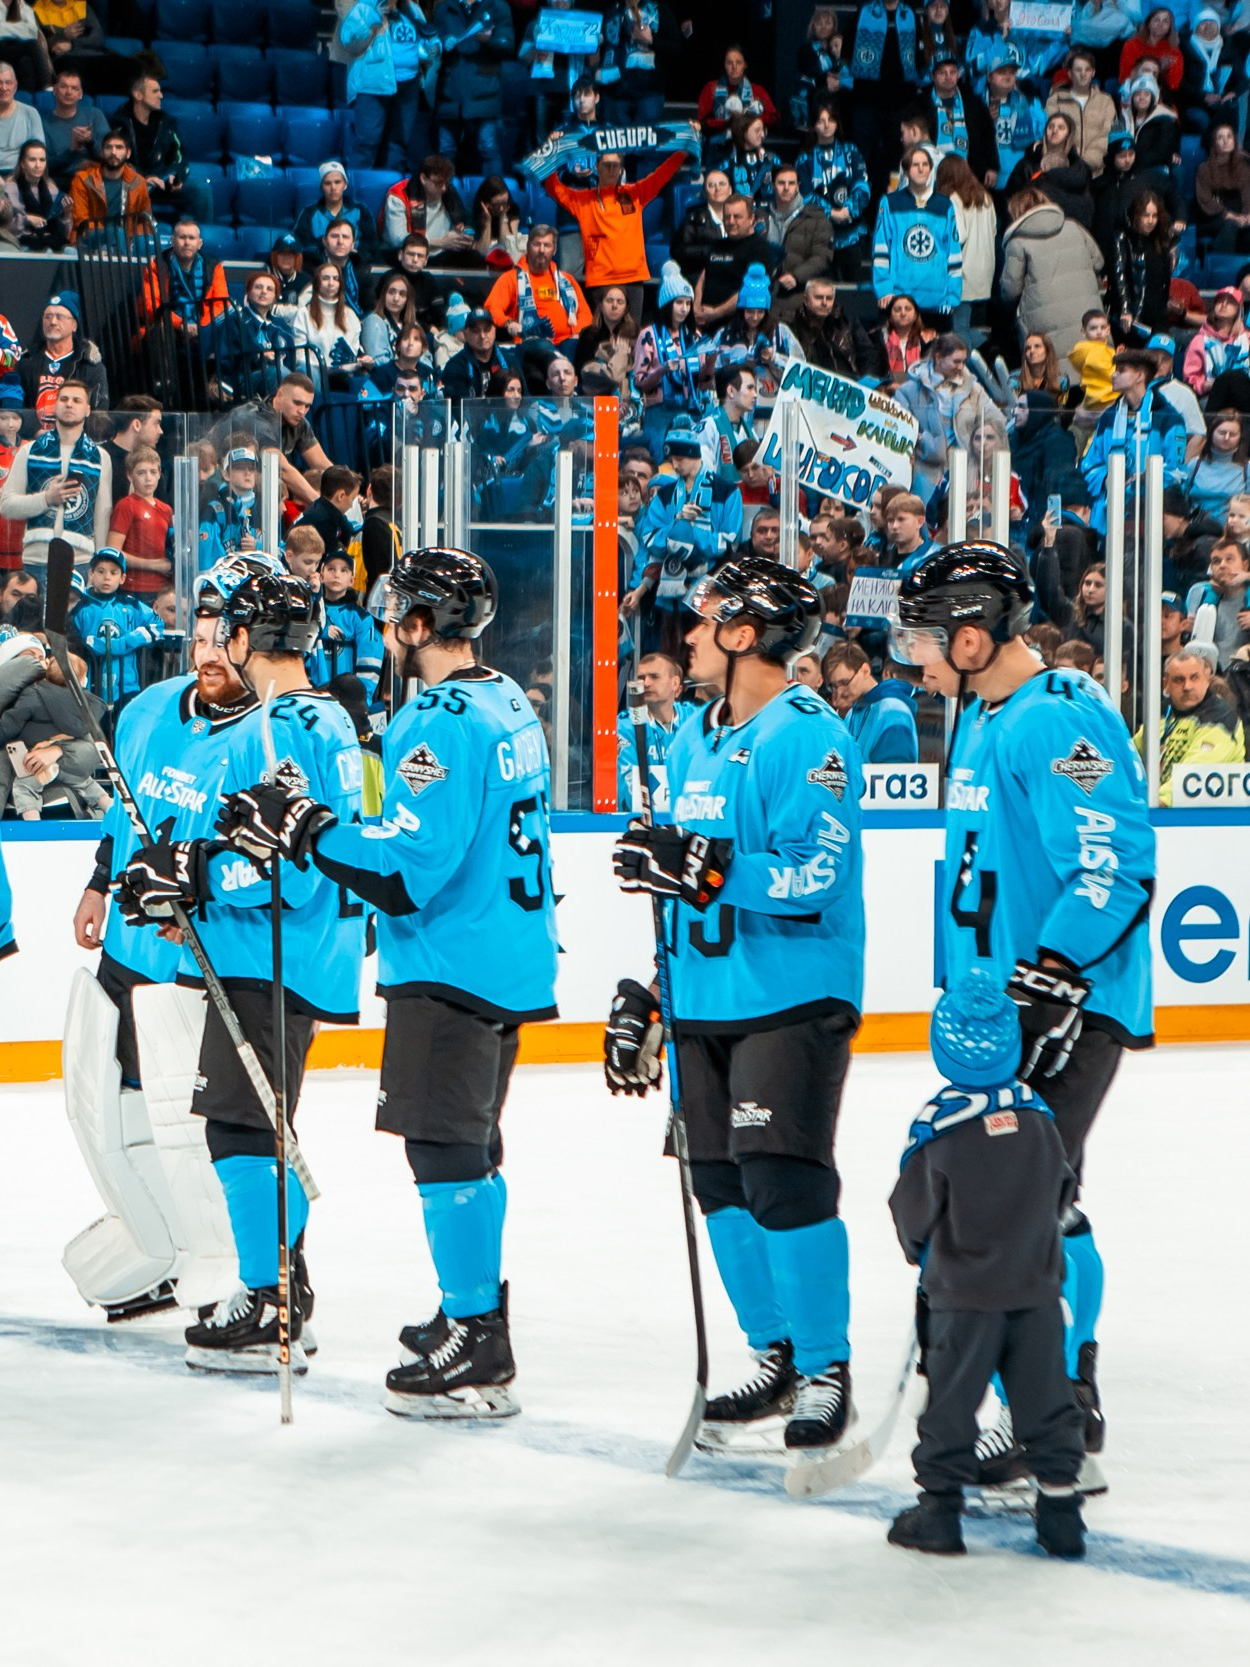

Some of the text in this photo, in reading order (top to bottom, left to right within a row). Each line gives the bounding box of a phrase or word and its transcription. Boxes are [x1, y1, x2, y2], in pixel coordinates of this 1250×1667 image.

[270, 697, 320, 731] 24
[417, 686, 472, 716] 55
[162, 766, 197, 784] FONBET
[395, 761, 450, 780] ERNYSHEV
[861, 773, 928, 800] газ
[183, 927, 227, 1011] RIBCOR
